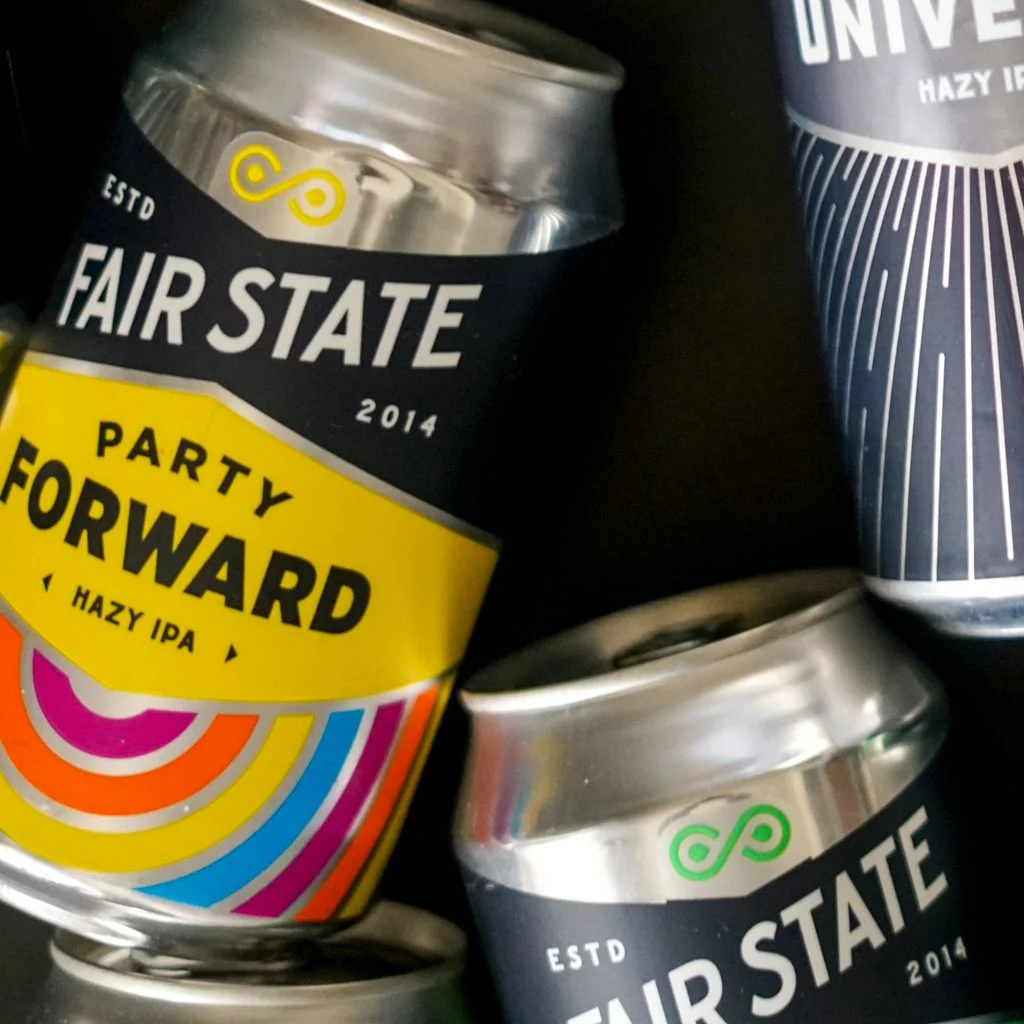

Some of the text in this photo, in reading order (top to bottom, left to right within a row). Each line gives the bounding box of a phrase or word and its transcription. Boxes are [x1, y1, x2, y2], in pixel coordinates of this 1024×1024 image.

[918, 67, 995, 104] HAZY
[102, 173, 156, 221] ESTD
[56, 241, 484, 370] FAIR STATE
[355, 398, 438, 439] 2014
[96, 420, 294, 519] PARTY
[0, 436, 373, 636] FORWARD
[71, 584, 196, 654] HAZY IPA
[739, 805, 948, 1018] STATE
[546, 937, 626, 973] ESTD
[905, 935, 968, 986] 2014
